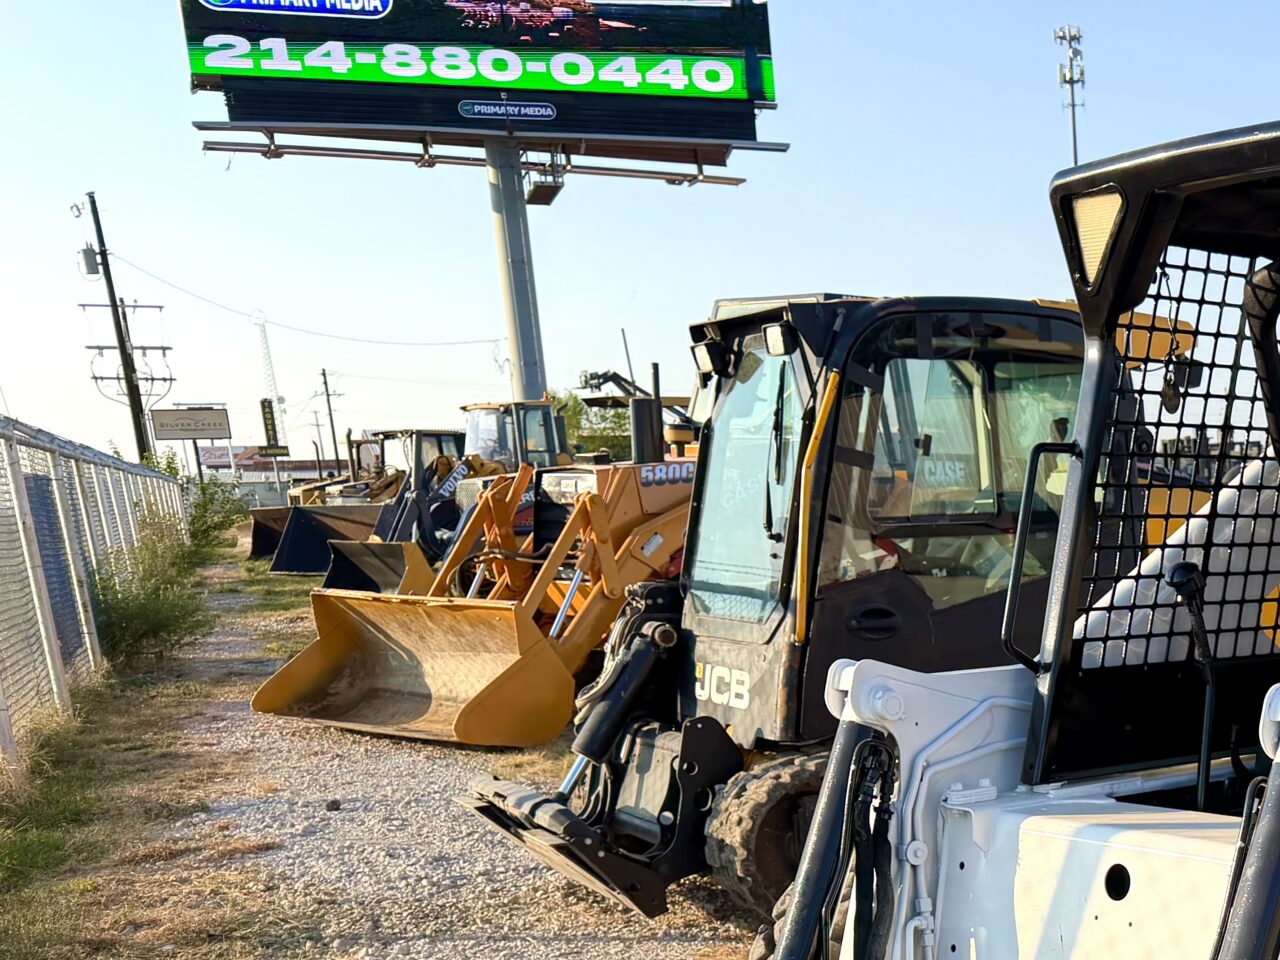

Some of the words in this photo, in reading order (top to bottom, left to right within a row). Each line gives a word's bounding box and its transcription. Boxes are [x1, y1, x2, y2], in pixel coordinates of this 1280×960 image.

[203, 35, 735, 92] 214-880-0440
[474, 105, 519, 115] PRIMARY
[520, 107, 553, 116] MEDIA
[263, 401, 276, 445] TAQUERIA
[439, 464, 469, 498] VOLVO
[641, 462, 695, 487] 580C
[924, 460, 966, 481] CASE
[695, 664, 750, 710] JCB
